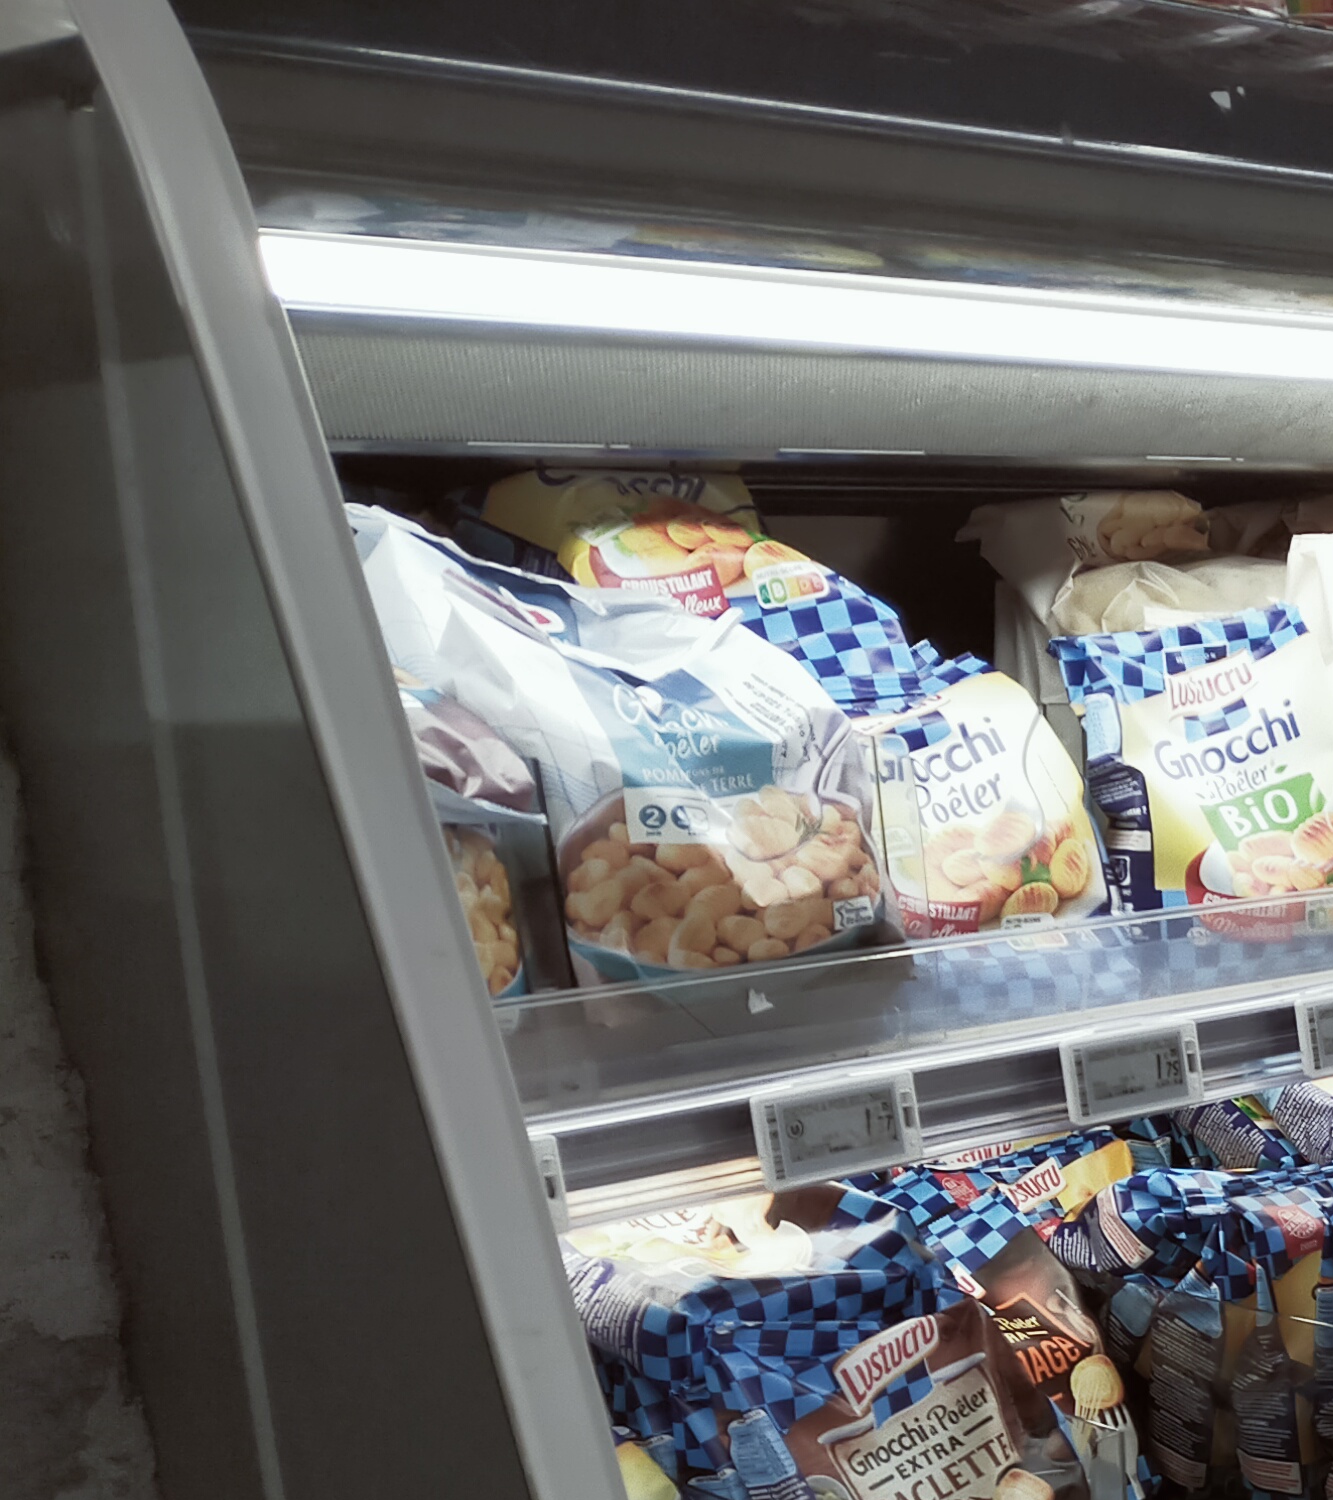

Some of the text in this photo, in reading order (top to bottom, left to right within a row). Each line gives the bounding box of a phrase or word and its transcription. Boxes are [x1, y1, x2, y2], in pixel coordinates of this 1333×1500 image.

[1153, 699, 1301, 781] Gnocchi
[840, 1314, 936, 1405] Lustucru
[848, 1418, 930, 1477] Gnocchi
[927, 1387, 989, 1432] Poêler
[897, 1434, 966, 1481] EXTRA
